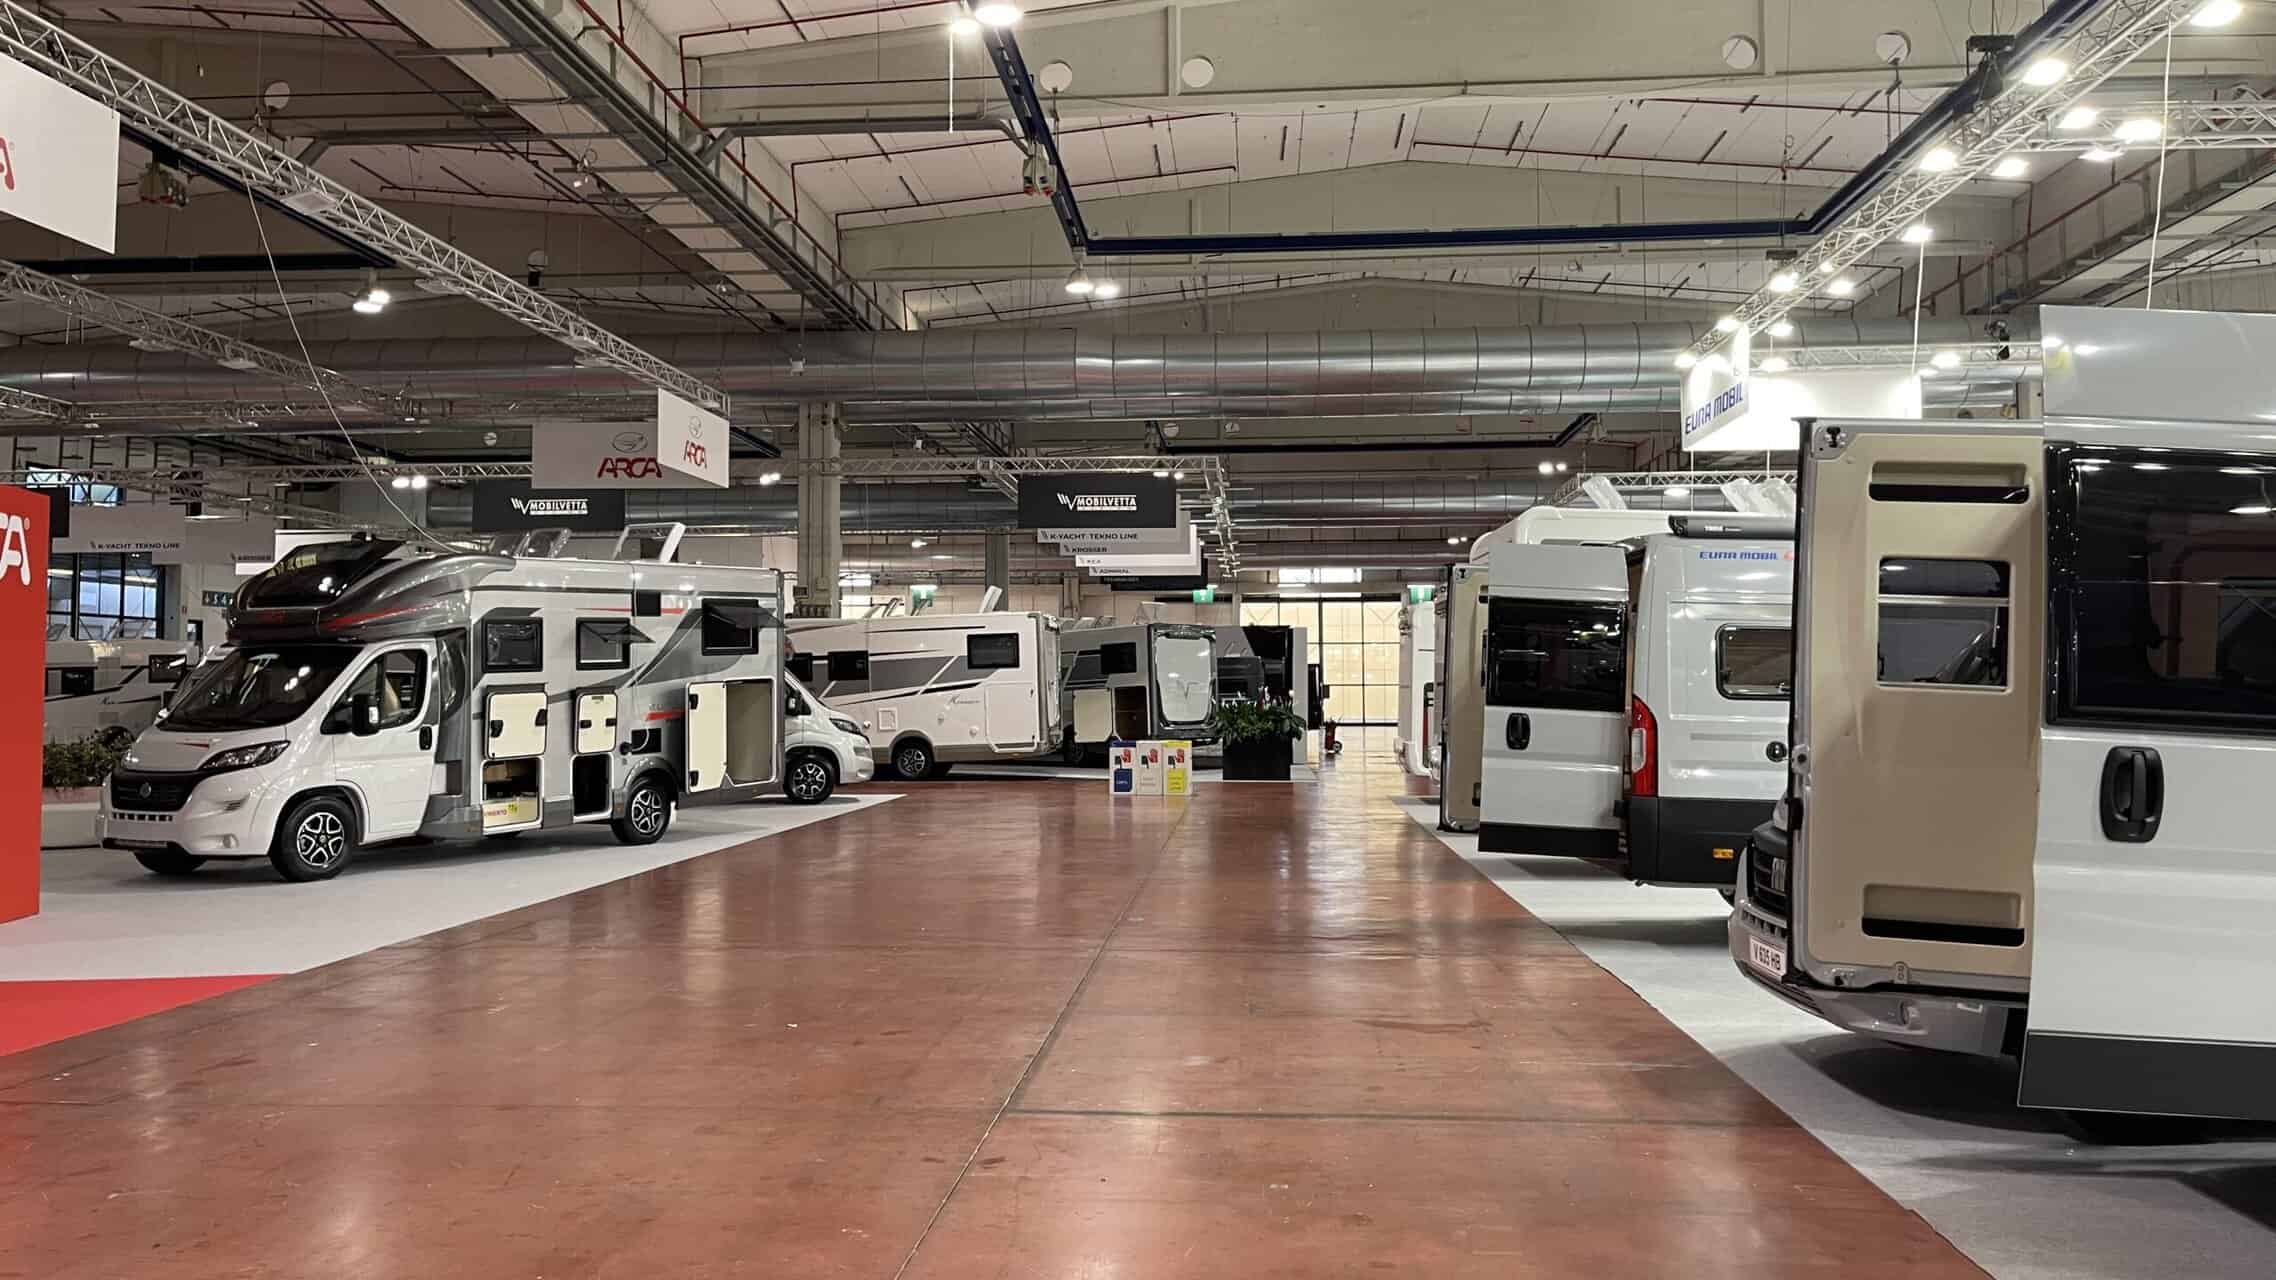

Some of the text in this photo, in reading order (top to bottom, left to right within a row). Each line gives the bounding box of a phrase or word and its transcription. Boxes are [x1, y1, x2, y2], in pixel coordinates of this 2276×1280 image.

[1713, 383, 1743, 419] MOBIL
[684, 440, 708, 469] ARCA
[597, 457, 662, 479] ARCA
[1739, 551, 1777, 560] MOBIL
